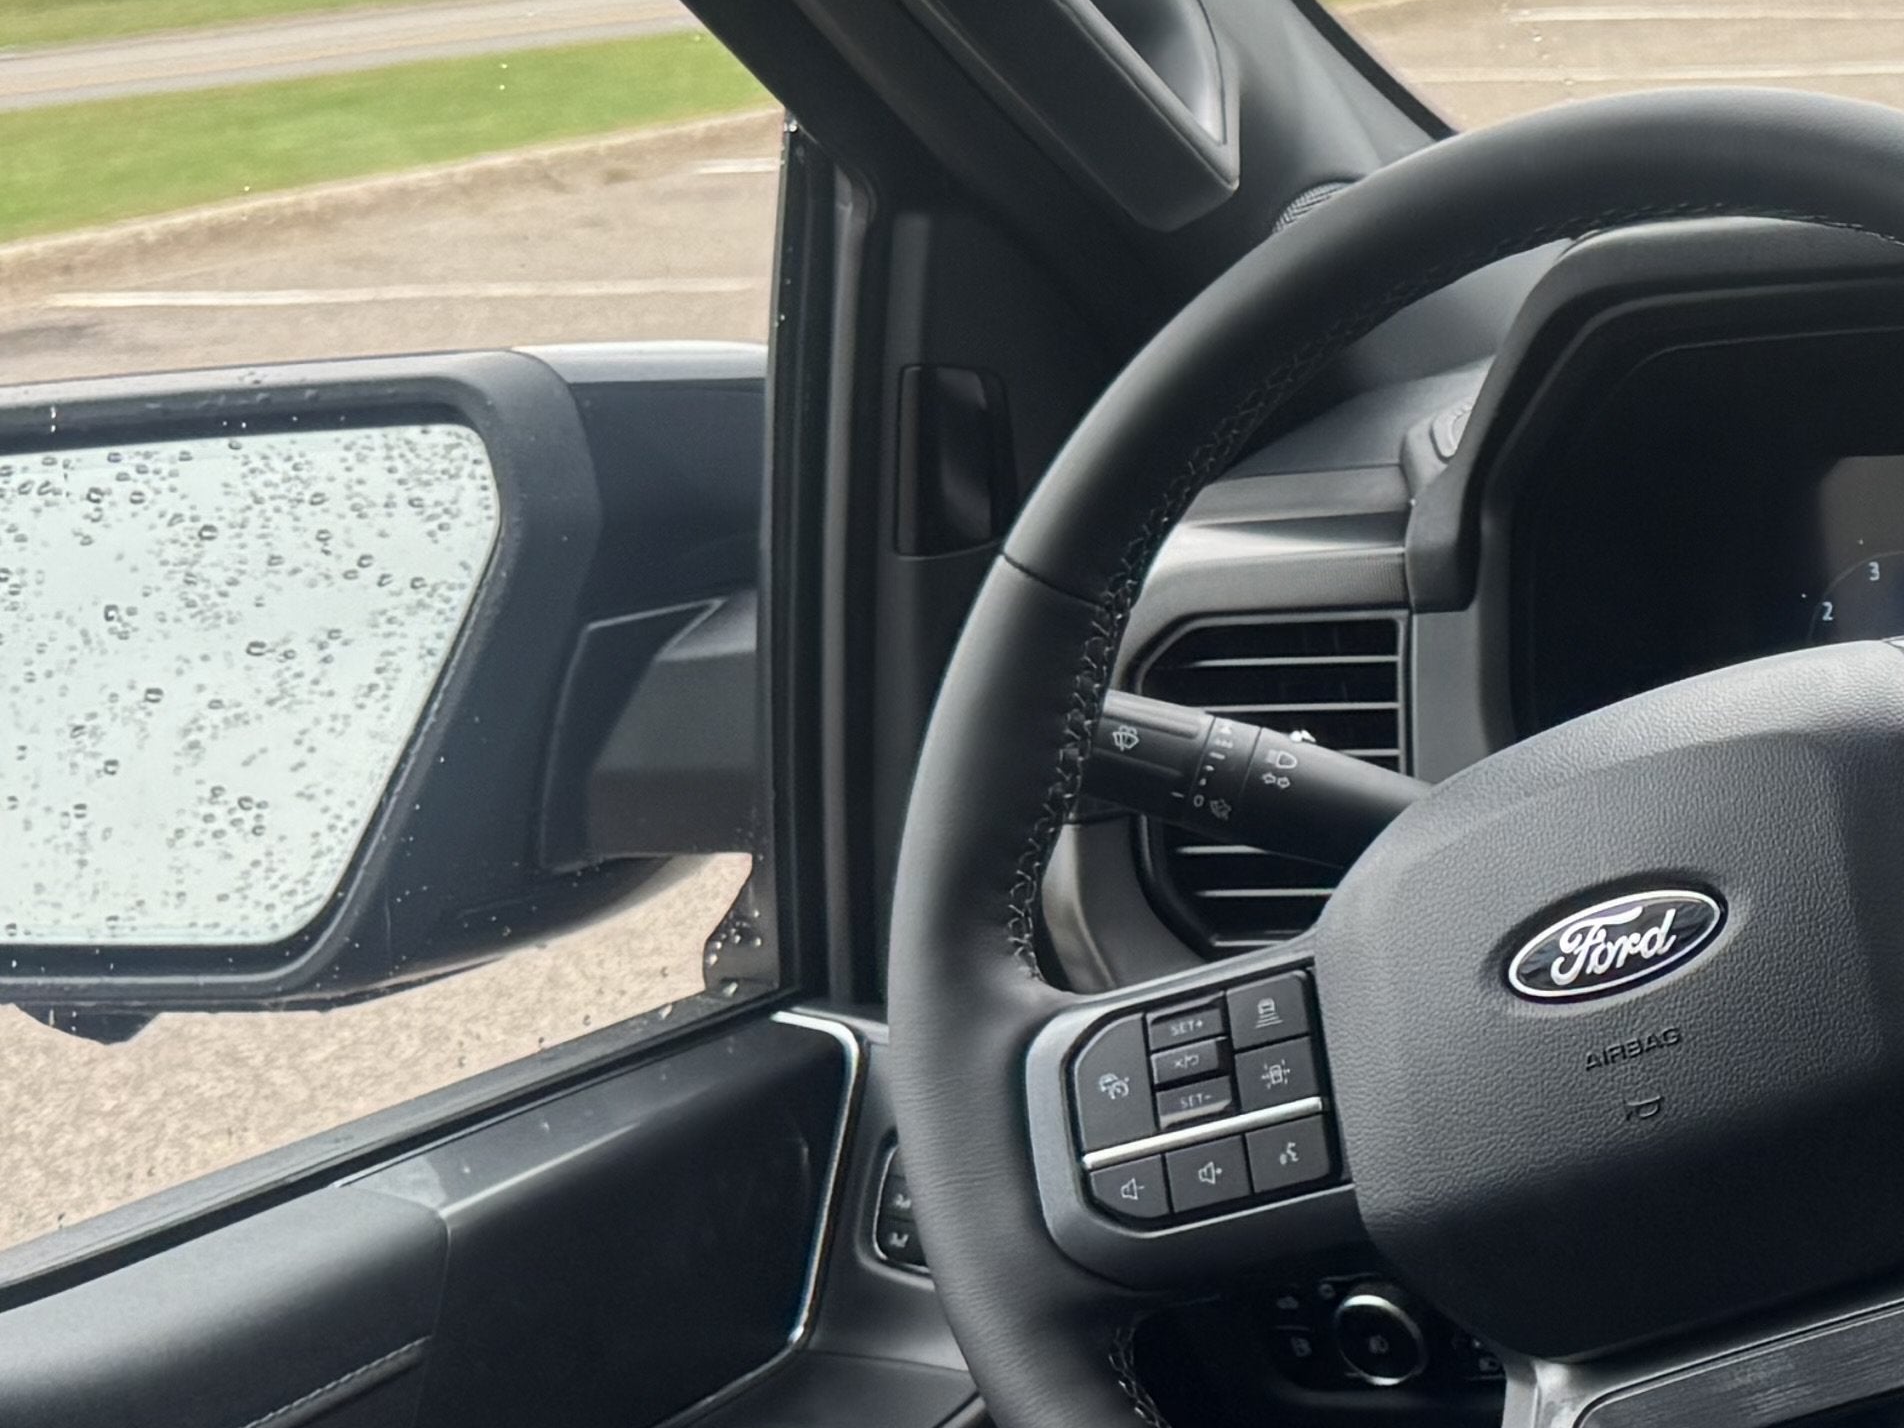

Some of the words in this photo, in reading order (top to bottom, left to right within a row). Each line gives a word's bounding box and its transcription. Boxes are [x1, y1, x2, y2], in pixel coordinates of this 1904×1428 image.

[1869, 562, 1880, 580] 3
[1822, 603, 1833, 621] 2
[1550, 906, 1676, 985] Ford
[1585, 1026, 1682, 1071] AIRBAG
